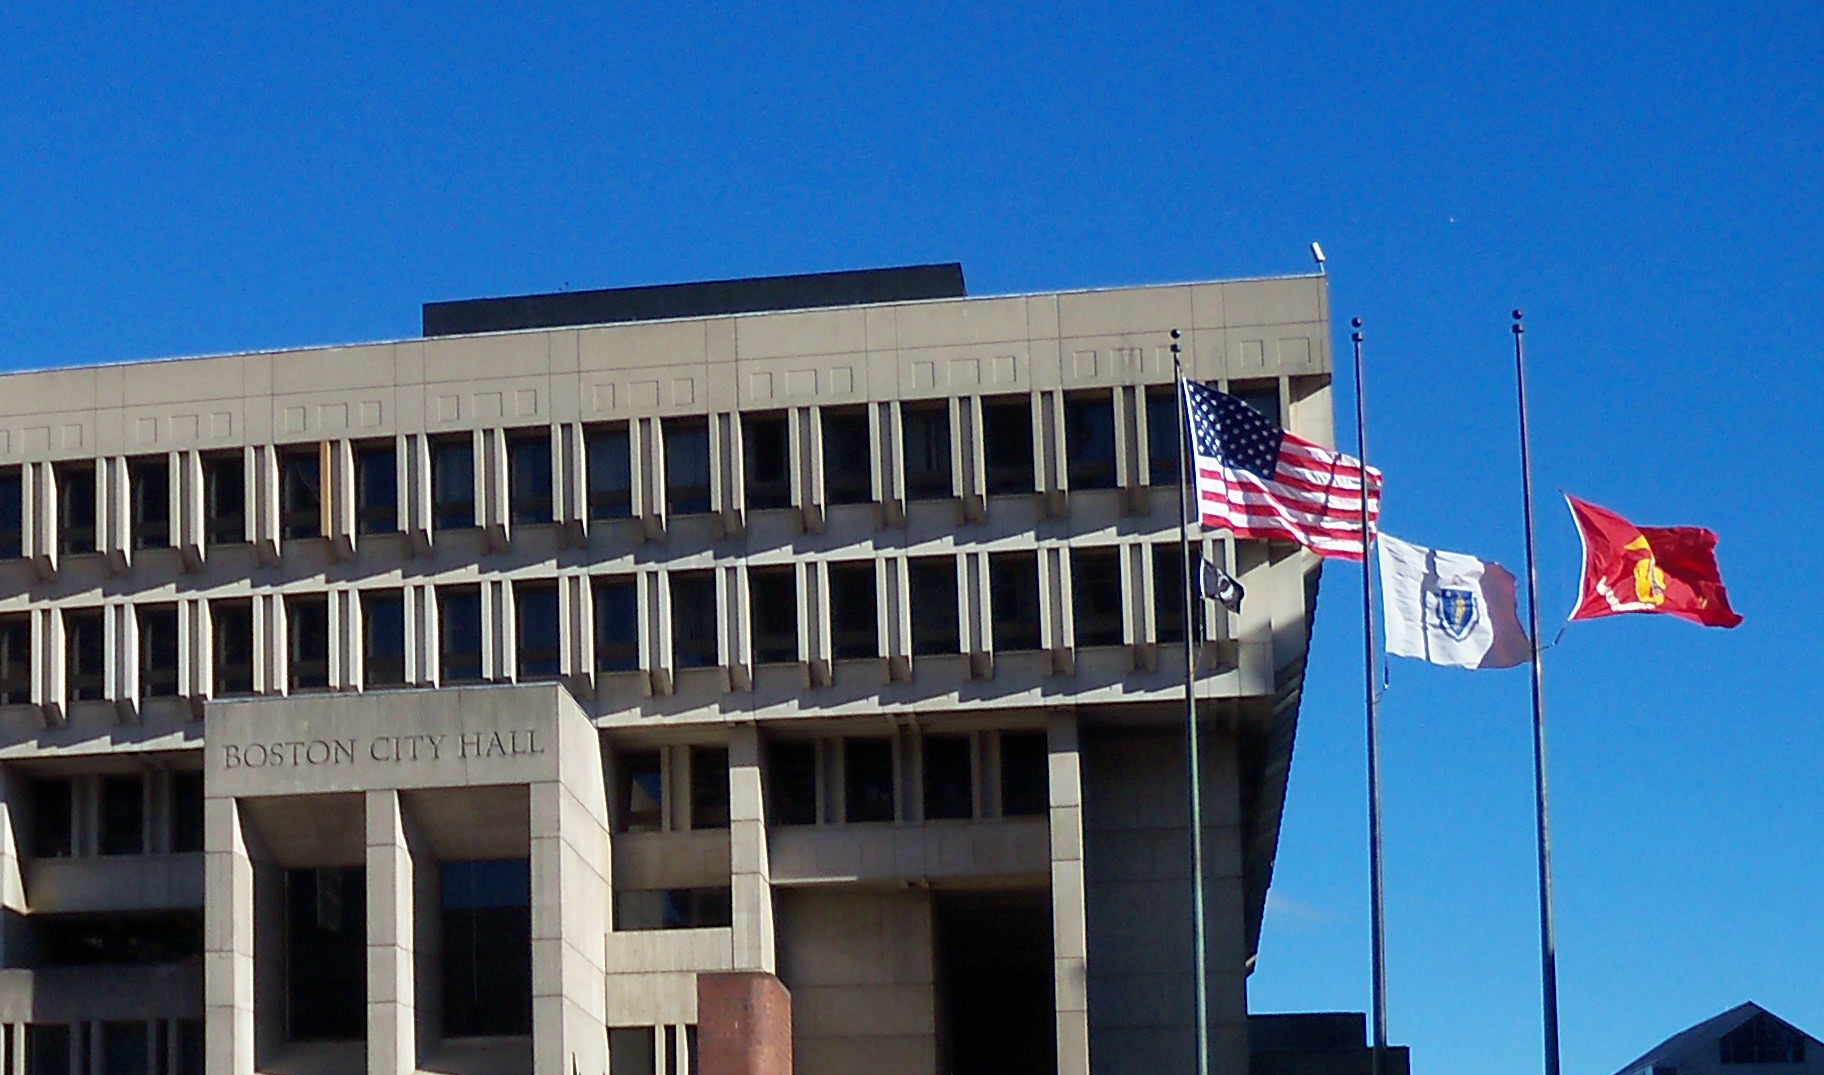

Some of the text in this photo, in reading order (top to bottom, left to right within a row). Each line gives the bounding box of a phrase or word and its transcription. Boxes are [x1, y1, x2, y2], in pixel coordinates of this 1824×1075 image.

[222, 729, 545, 769] BOSTON CITY HALL
